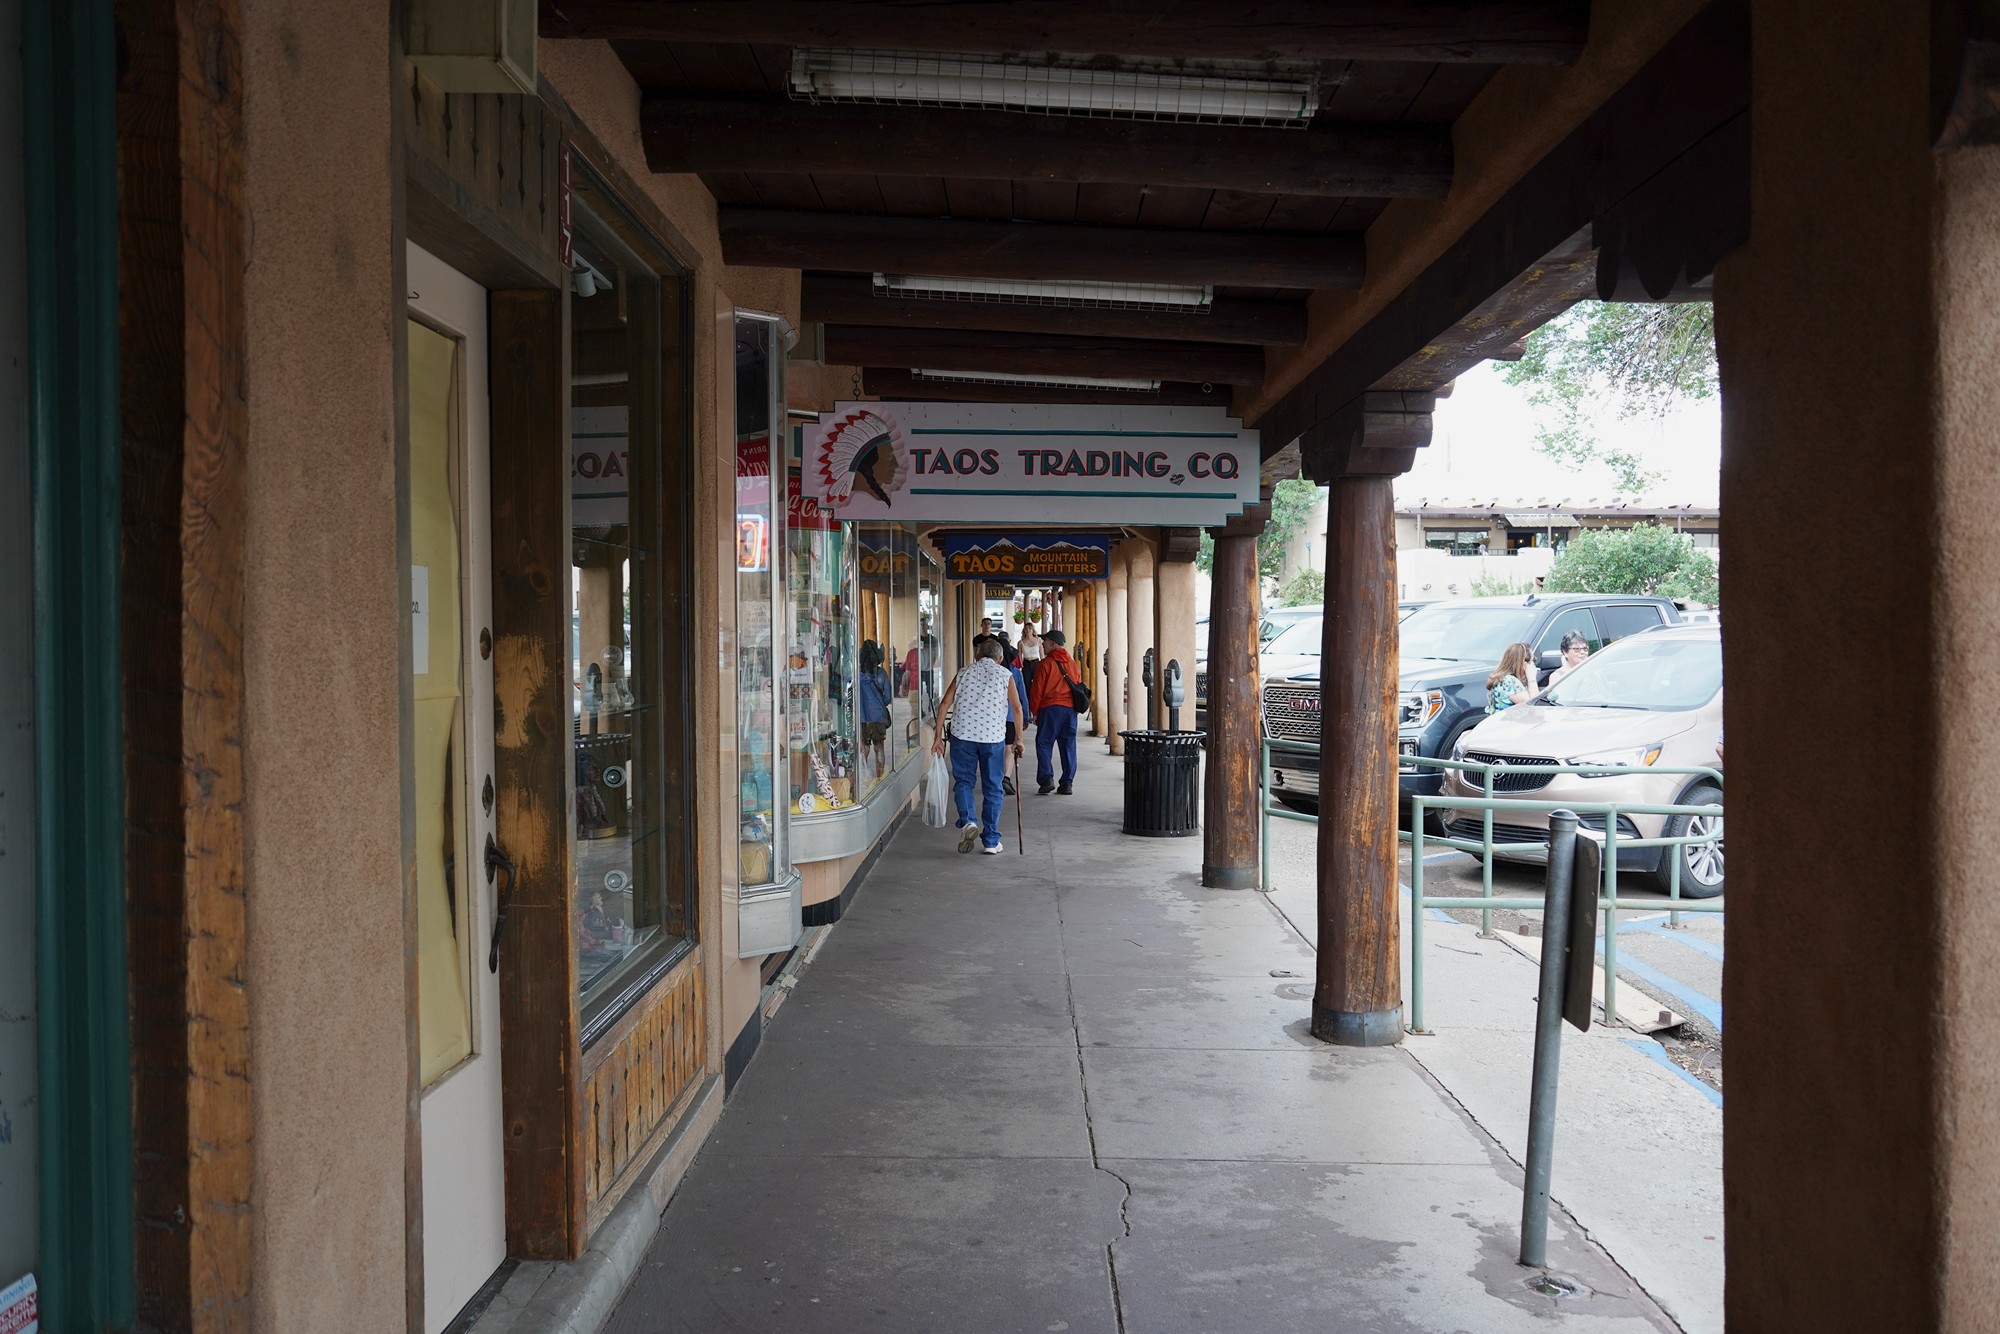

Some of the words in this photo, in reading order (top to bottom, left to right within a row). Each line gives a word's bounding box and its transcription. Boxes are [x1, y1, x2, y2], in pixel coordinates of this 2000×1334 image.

[911, 448, 999, 475] TAOS
[1018, 449, 1171, 478] TRADING
[953, 554, 1015, 573] TAOS
[1029, 553, 1088, 563] MOUNTAIN
[1023, 563, 1097, 573] OUTFITTERS
